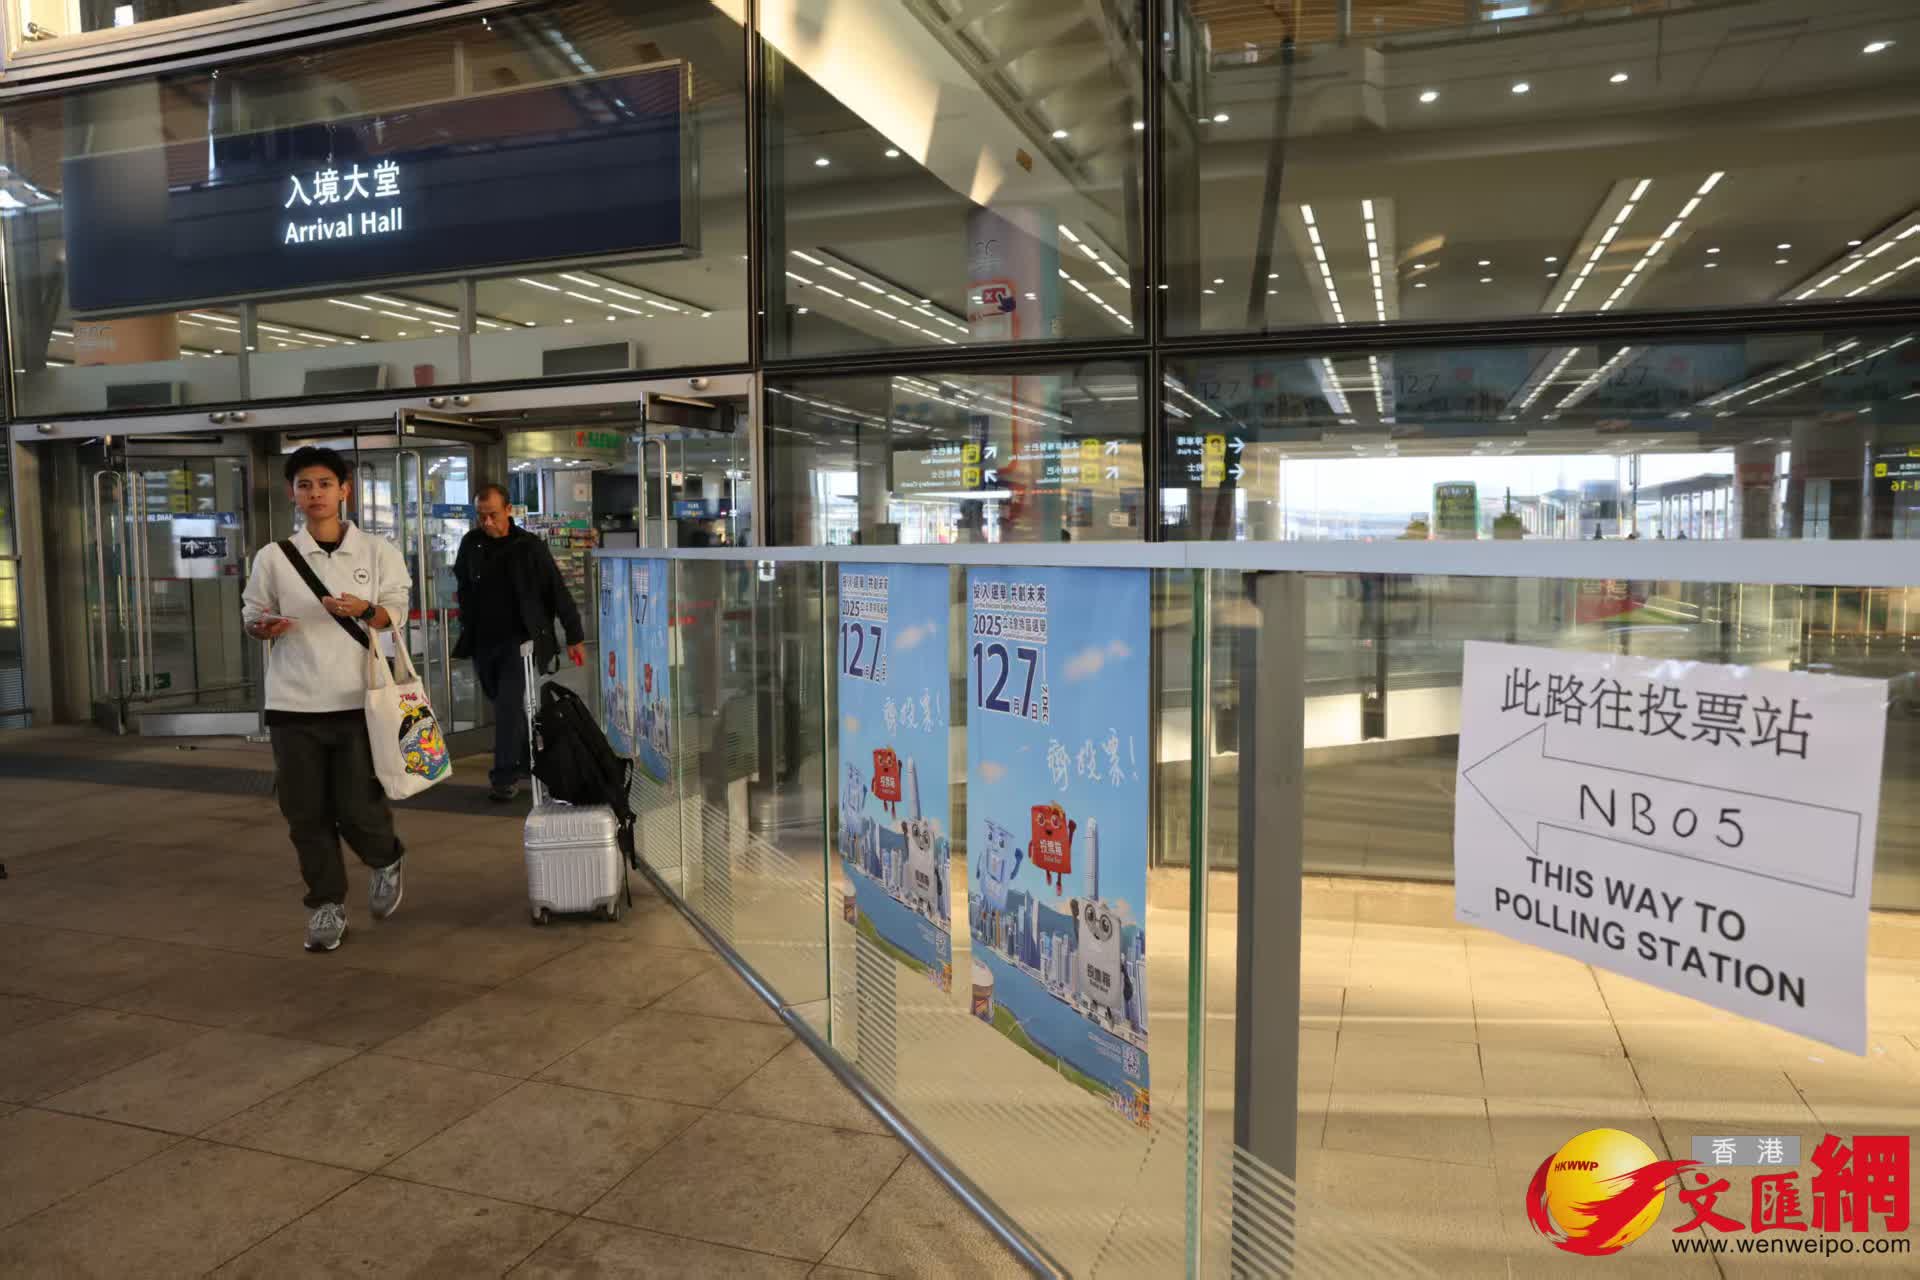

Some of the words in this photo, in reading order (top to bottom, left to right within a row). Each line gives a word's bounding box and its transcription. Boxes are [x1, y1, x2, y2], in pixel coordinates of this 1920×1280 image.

[284, 159, 401, 209] 入境大堂
[284, 213, 353, 244] Arrival
[361, 206, 402, 234] Hall
[973, 614, 1002, 635] 2025
[1501, 667, 1814, 759] 此路往投票站
[1526, 856, 1593, 899] THIS
[1605, 876, 1683, 924] WAY
[1695, 901, 1746, 942] TO
[1495, 887, 1625, 951] POLLING
[1637, 931, 1805, 1008] STATION
